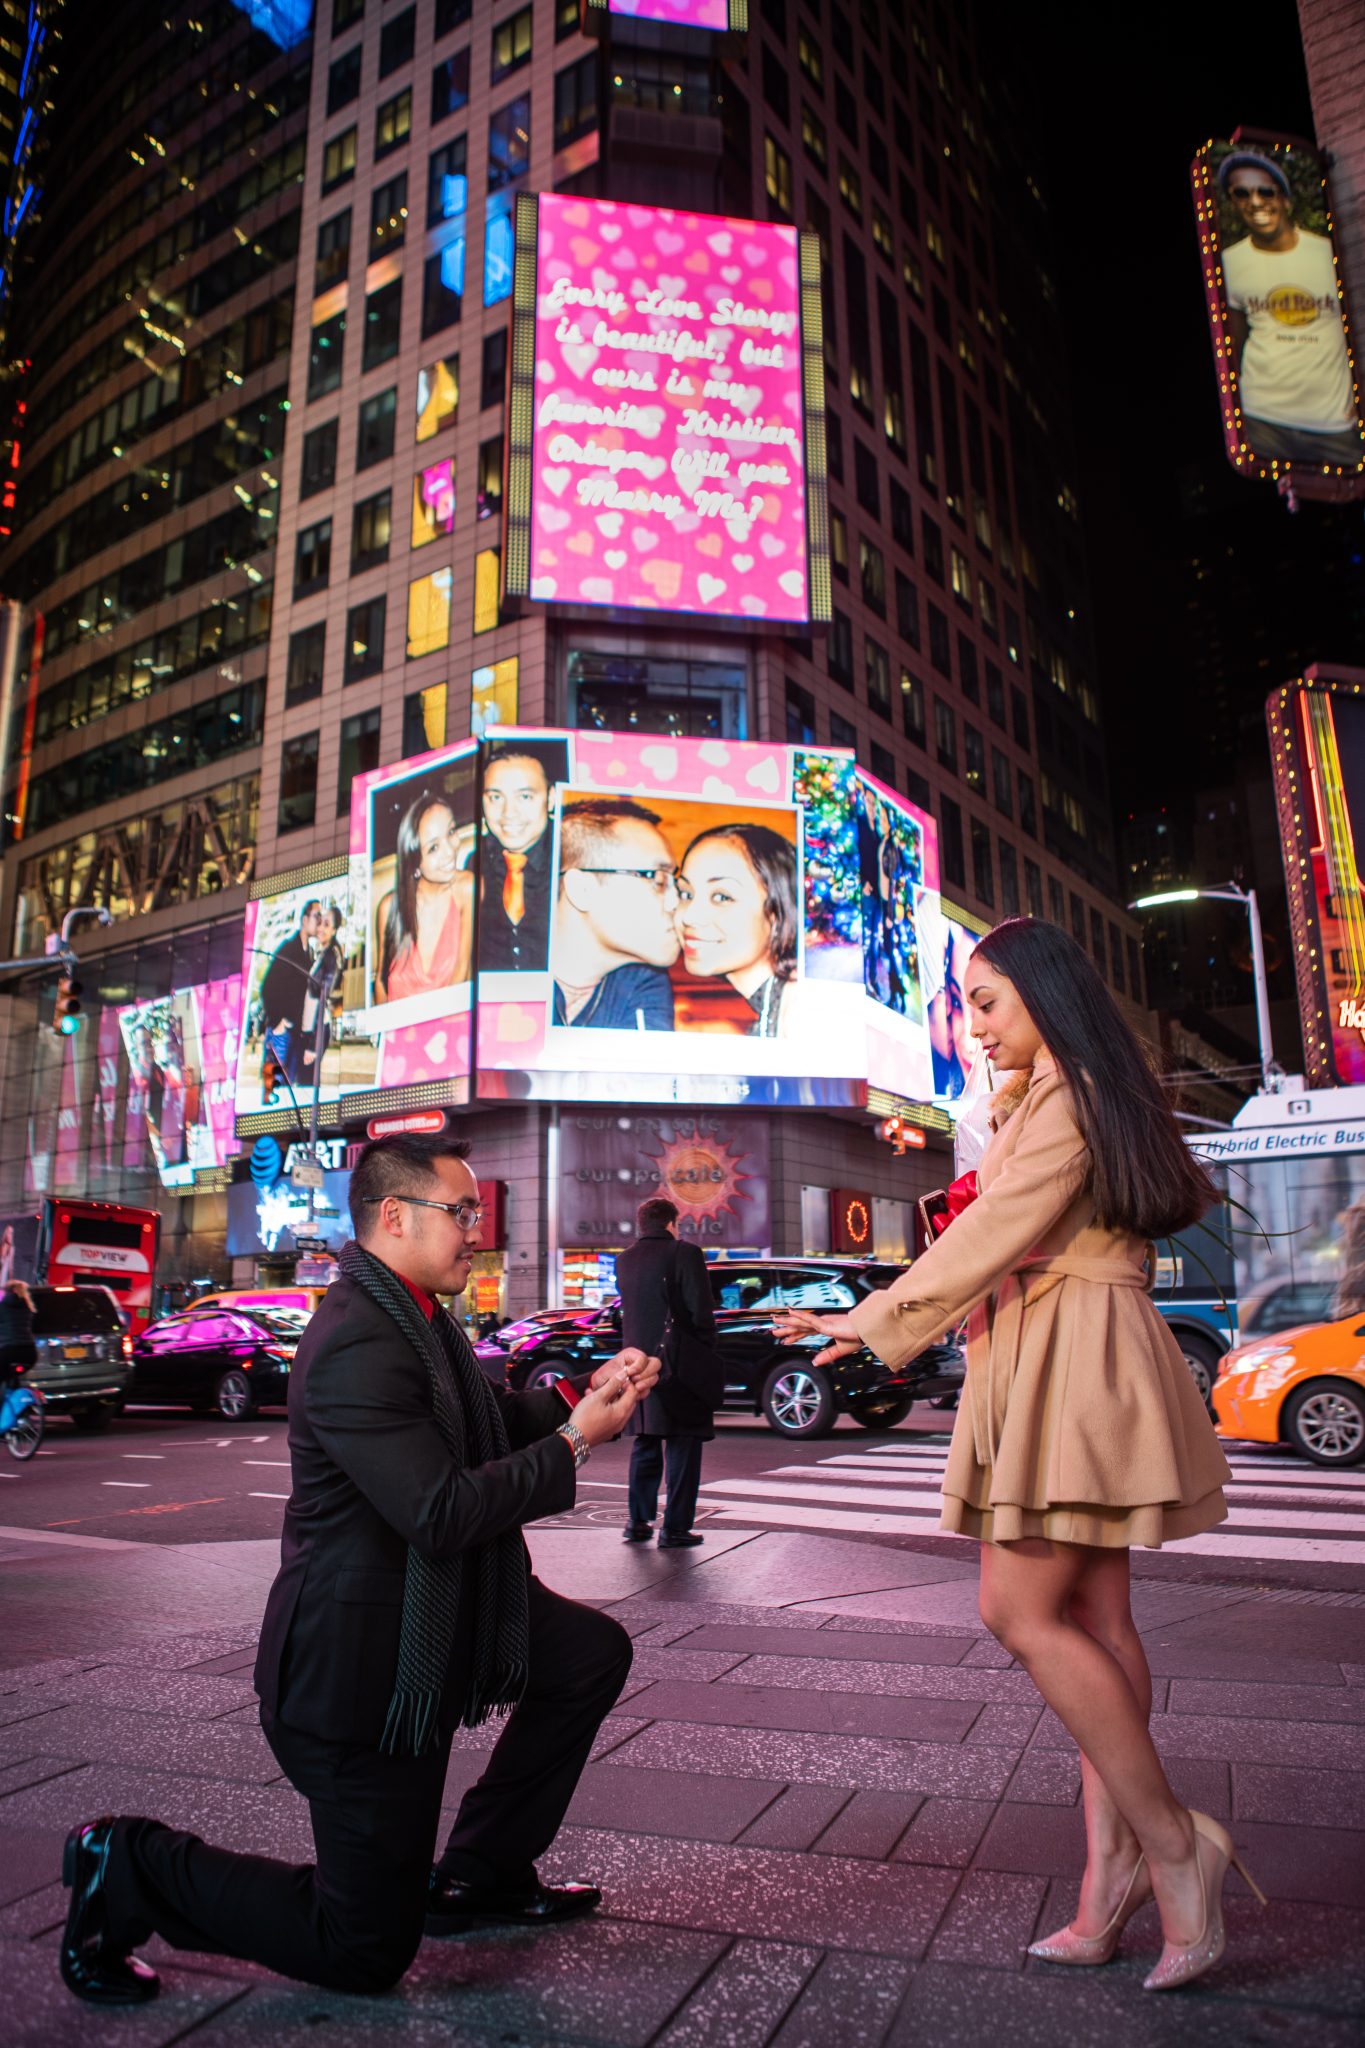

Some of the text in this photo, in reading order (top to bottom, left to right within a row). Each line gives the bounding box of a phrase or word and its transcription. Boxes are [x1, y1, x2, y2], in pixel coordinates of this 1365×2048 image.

[545, 278, 627, 315] Every
[635, 289, 704, 320] Love
[555, 316, 585, 344] is
[740, 339, 784, 367] but
[592, 368, 747, 407] ours is my
[671, 448, 730, 479] Will
[738, 462, 791, 488] you
[577, 478, 764, 523] Marry Me?
[1206, 1137, 1259, 1156] Hybrid
[1265, 1131, 1327, 1150] Electric
[1334, 1129, 1365, 1145] Bus
